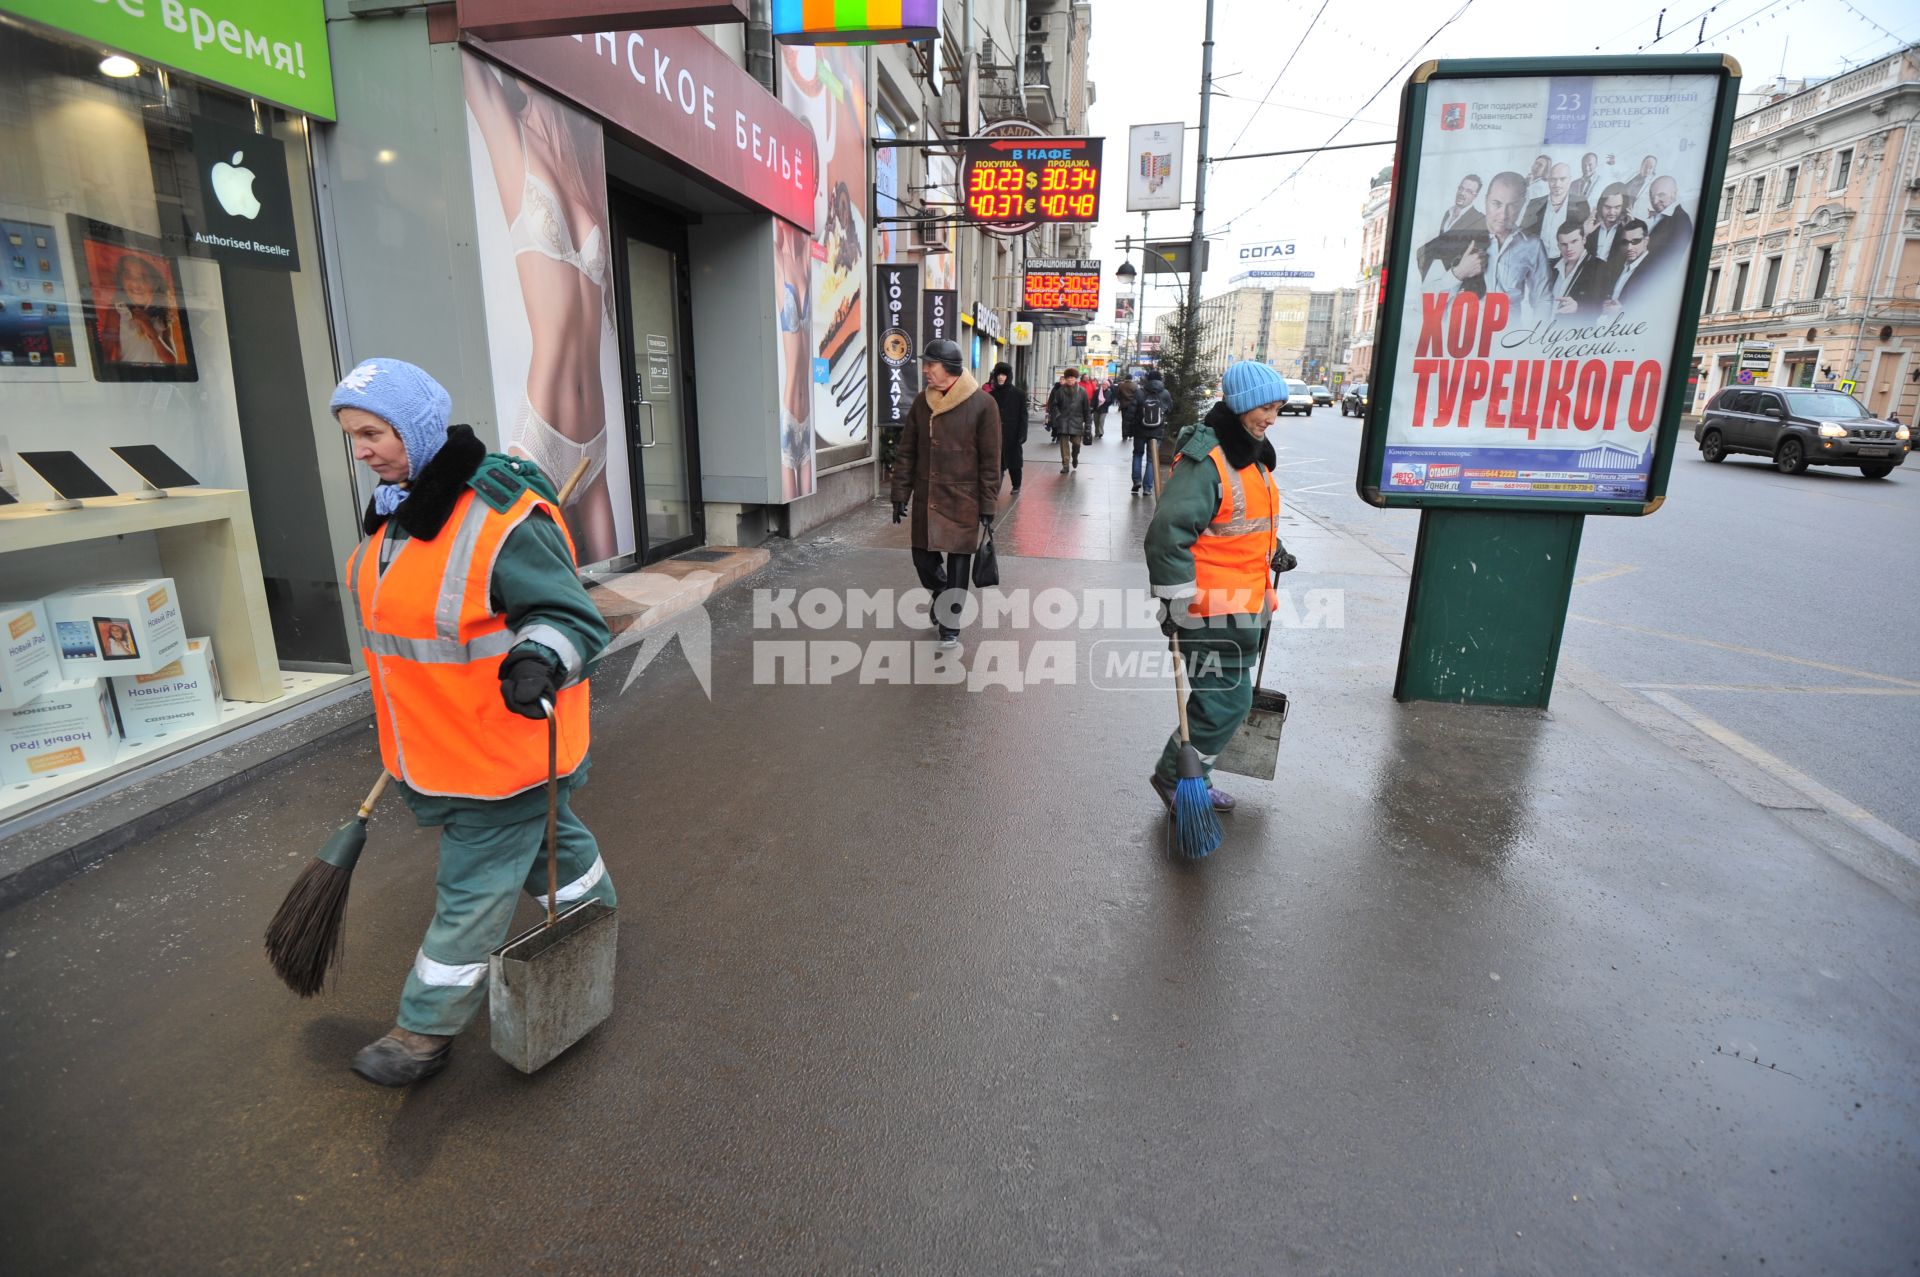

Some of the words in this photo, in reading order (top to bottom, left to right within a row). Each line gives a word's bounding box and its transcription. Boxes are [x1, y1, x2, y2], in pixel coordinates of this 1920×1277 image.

[161, 0, 305, 79] время!
[1556, 94, 1581, 110] 23
[1594, 92, 1697, 104] ГОСУДАРСТВЕННЫЙ
[571, 32, 716, 130] НСКОЕ
[735, 109, 803, 189] БЕЛЬЁ
[1472, 113, 1533, 121] Правительства
[1592, 105, 1669, 116] КРЕМЛЕВСКИЙ
[1013, 150, 1022, 160] В
[1027, 149, 1071, 159] КАФЕ
[1048, 160, 1089, 168] ПРОДАЖА
[971, 169, 1023, 190] 30.23
[1042, 169, 1096, 190] 30.34
[970, 195, 1023, 216] 40.37
[1042, 195, 1094, 216] 40.48
[195, 232, 251, 250] Authorised
[253, 242, 290, 256] Reseller
[1240, 244, 1295, 259] СОГАЗ
[1027, 260, 1076, 268] ОПЕРАЦИОННАЯ
[1081, 260, 1099, 268] КАССА
[1026, 276, 1060, 290] 30.35
[1064, 276, 1098, 290] 30.45
[889, 272, 902, 326] КОФЕ
[1025, 293, 1060, 307] 40.55
[1064, 293, 1098, 308] 40.65
[933, 295, 944, 338] КОФЕ
[1415, 292, 1509, 358] ХОР
[1501, 312, 1648, 353] Мужские
[890, 369, 902, 419] ХАУЗ
[1412, 359, 1662, 440] ТУРЕЦКОГО
[148, 613, 165, 628] Новый
[165, 608, 176, 619] iPad
[8, 640, 32, 656] Новый
[32, 632, 46, 645] iPad
[128, 683, 170, 697] Новый
[173, 681, 197, 692] iPad
